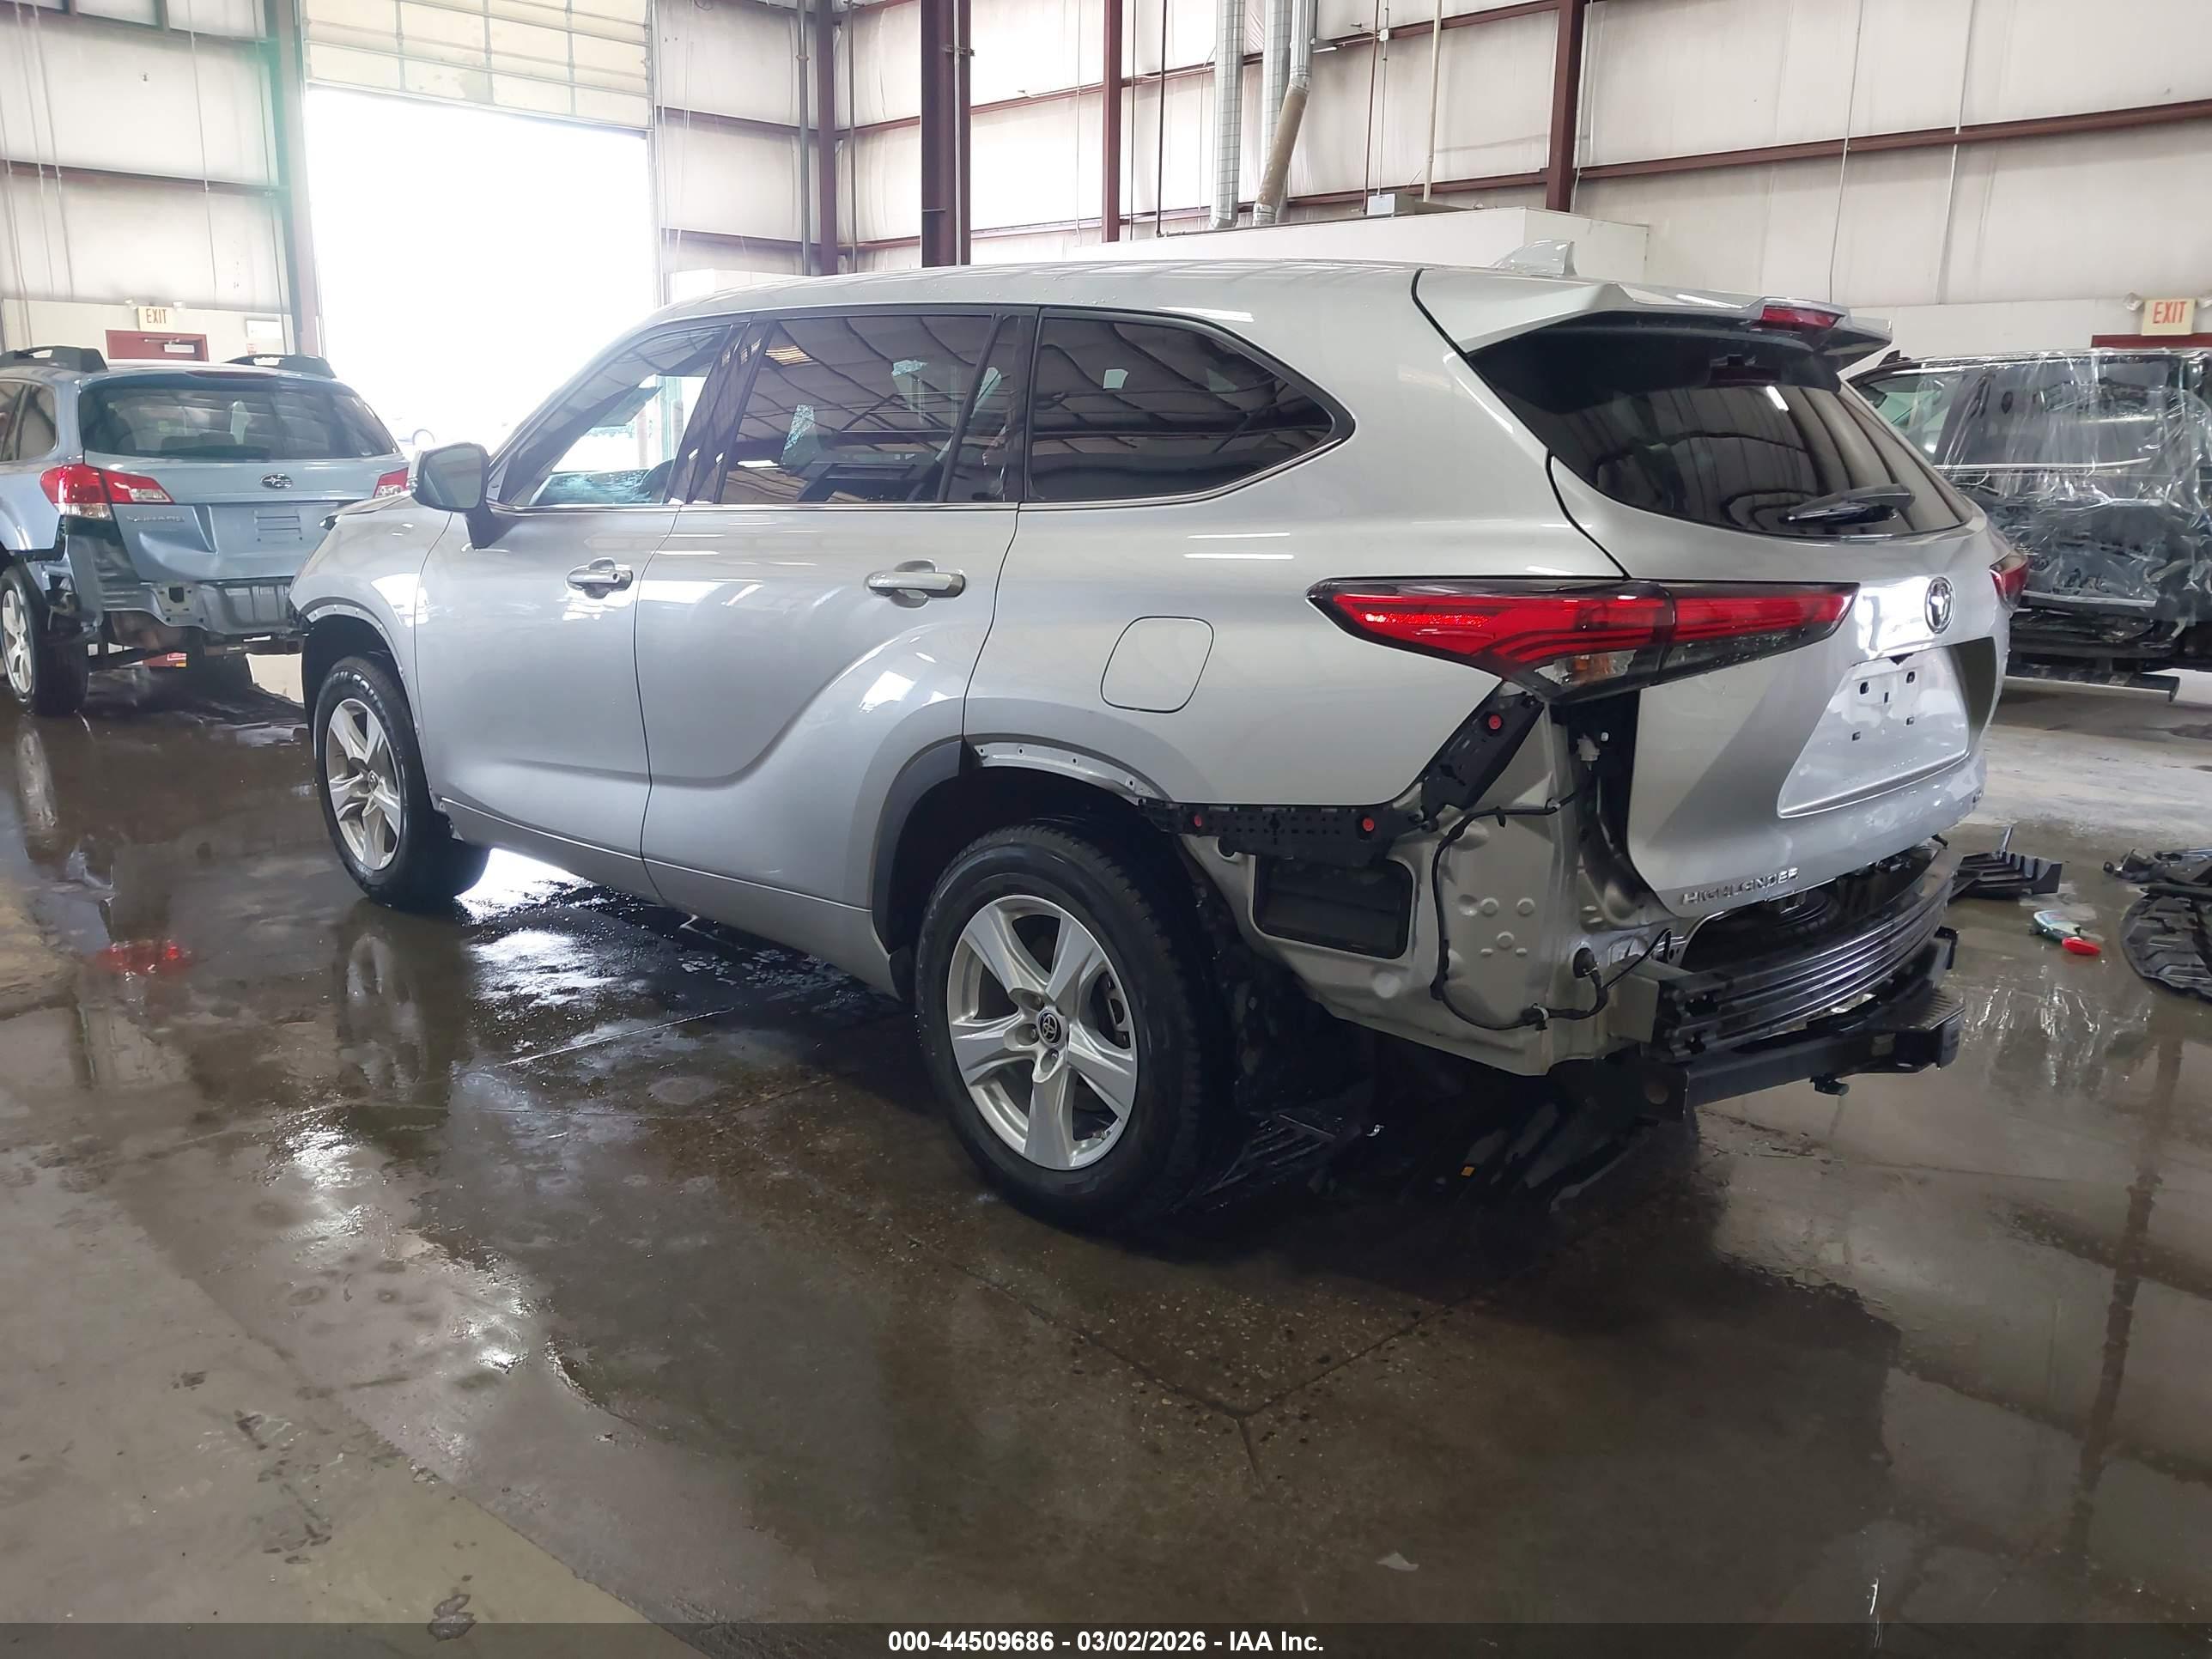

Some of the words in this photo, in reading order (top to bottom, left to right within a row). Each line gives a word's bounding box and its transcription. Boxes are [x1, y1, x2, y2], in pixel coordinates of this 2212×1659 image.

[146, 308, 167, 324] EXIT
[2152, 301, 2186, 324] EXIT
[1680, 866, 1799, 904] HIGHLANDER
